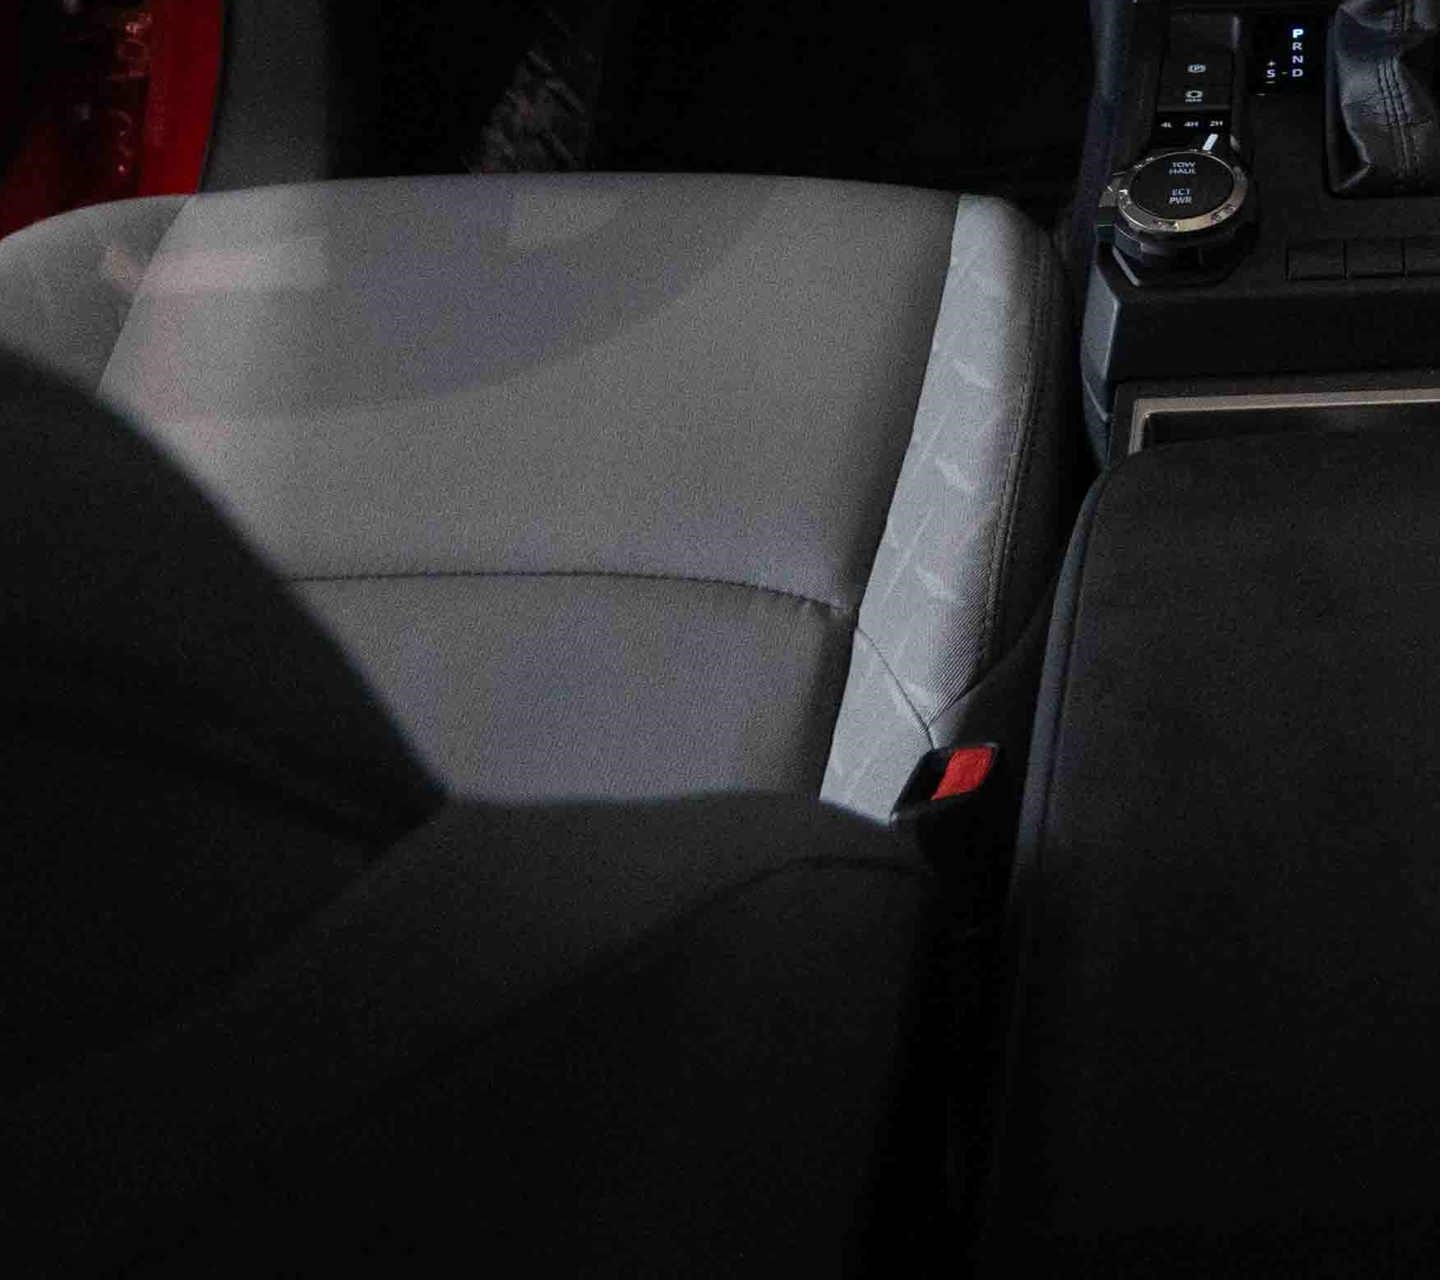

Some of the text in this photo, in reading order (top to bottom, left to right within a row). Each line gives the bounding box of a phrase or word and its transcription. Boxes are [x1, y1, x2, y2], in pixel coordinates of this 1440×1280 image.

[1292, 28, 1304, 78] P R N D
[1266, 68, 1276, 78] S
[1172, 188, 1191, 196] ECT
[1169, 197, 1193, 205] PWR
